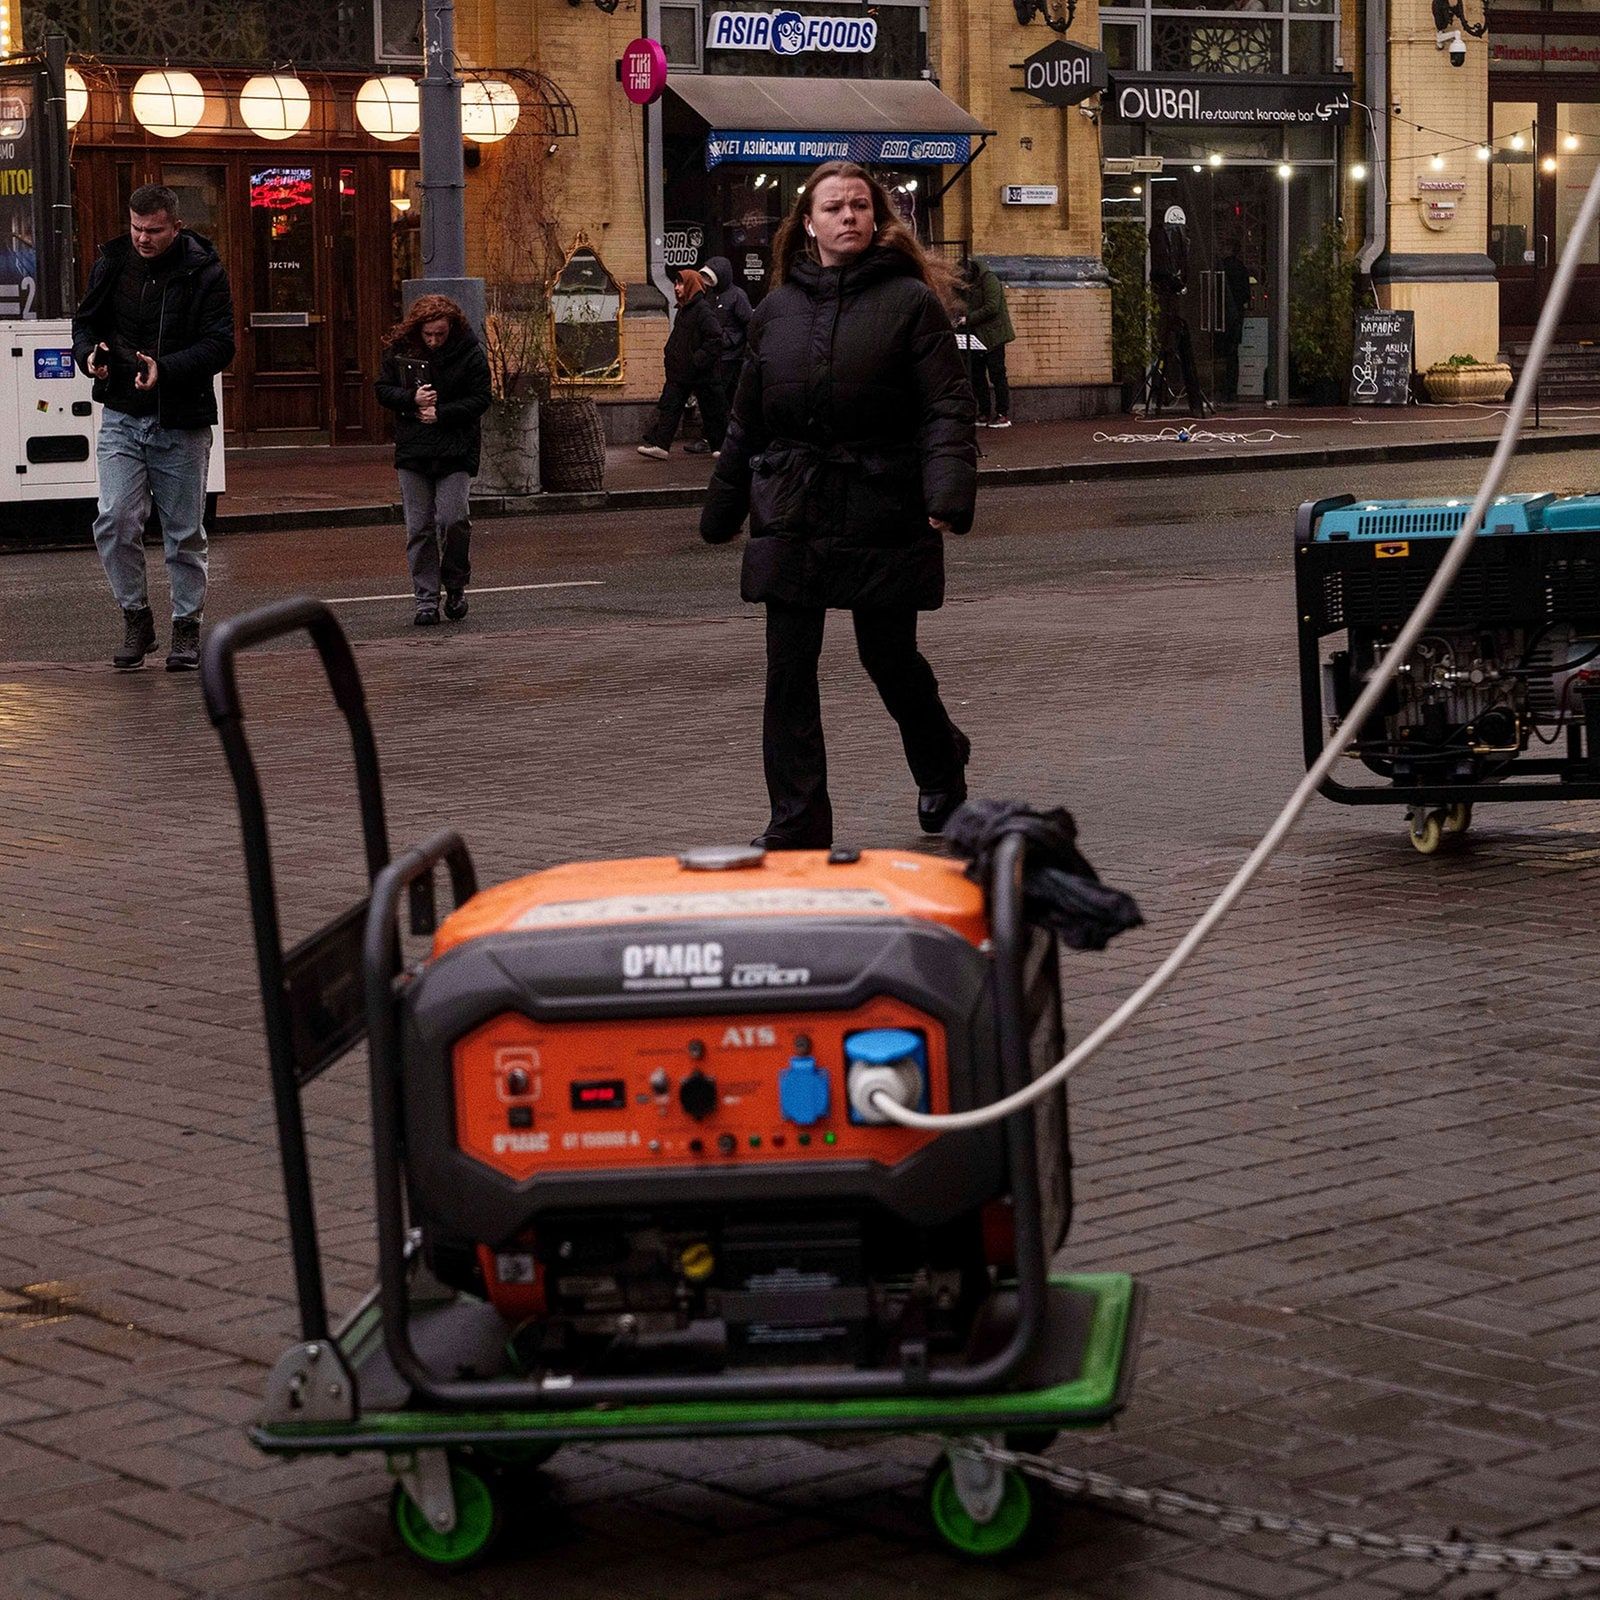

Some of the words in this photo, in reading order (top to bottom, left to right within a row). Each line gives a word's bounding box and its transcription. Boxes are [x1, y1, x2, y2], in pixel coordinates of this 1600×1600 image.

[716, 16, 770, 45] ASIA
[806, 20, 874, 49] FOODS
[629, 53, 651, 73] TIKI
[629, 73, 651, 89] THAI
[1200, 109, 1255, 121] restaurant
[1256, 108, 1297, 122] karaoke
[1297, 109, 1315, 122] bar
[743, 138, 796, 156] АЗІЙСЬКИХ
[799, 141, 849, 158] ПРОДУКТІВ
[881, 141, 909, 157] ASIA
[922, 142, 956, 158] FOODS
[720, 1024, 777, 1048] ATS
